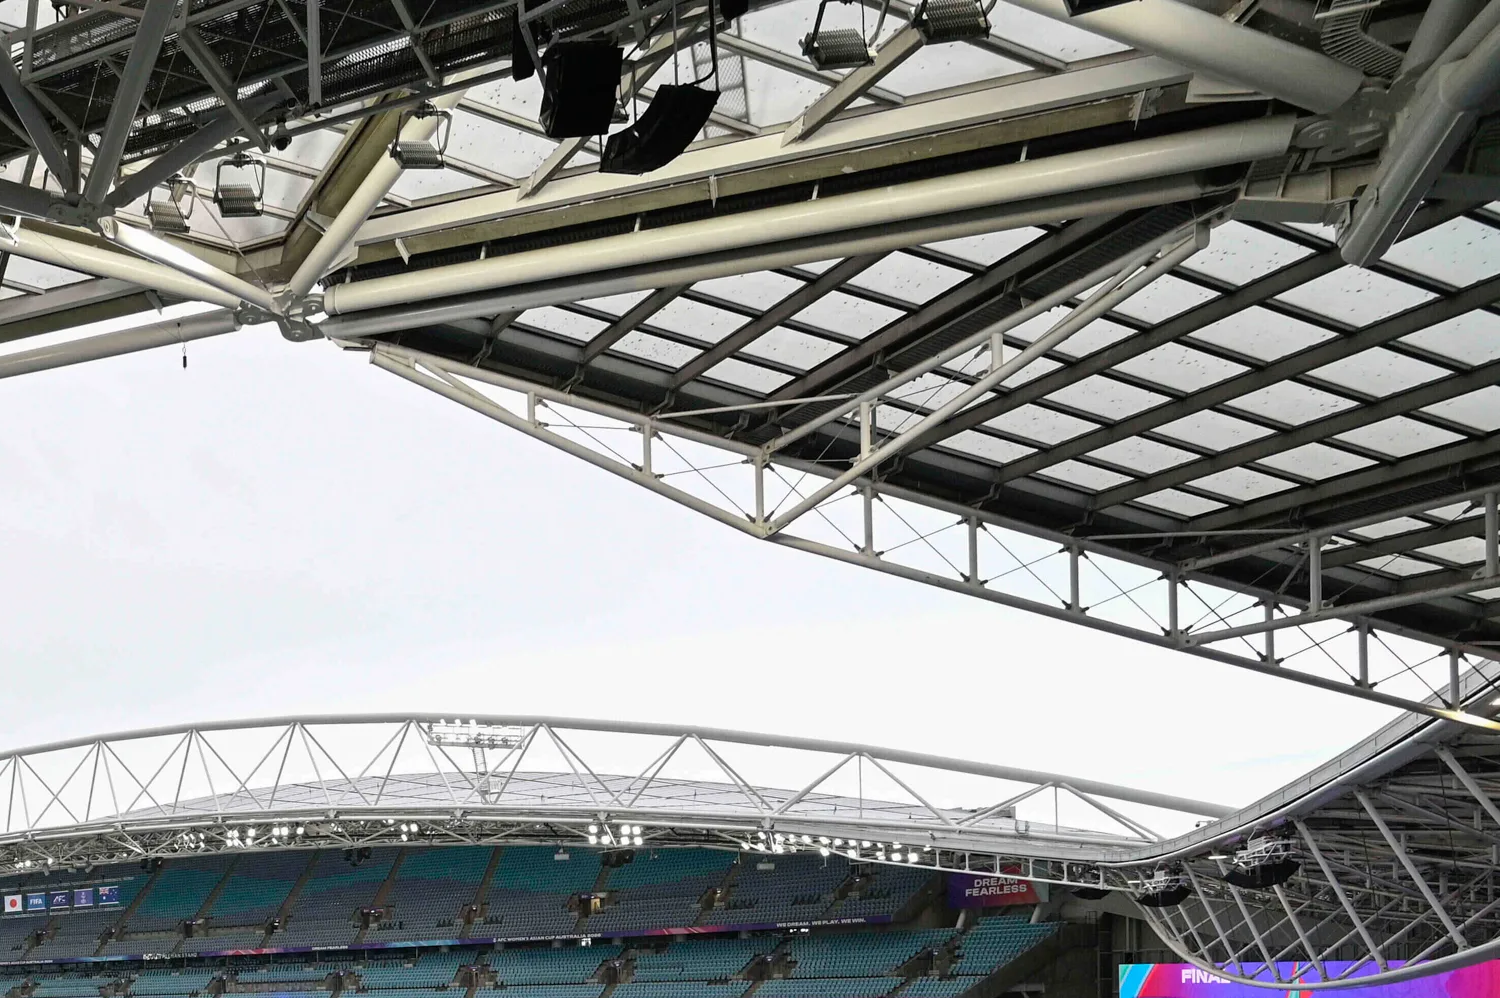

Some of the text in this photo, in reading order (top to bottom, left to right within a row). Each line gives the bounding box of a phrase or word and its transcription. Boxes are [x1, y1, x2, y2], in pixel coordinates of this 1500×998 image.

[974, 877, 1017, 887] DREAM
[966, 884, 1027, 897] FEARLESS
[53, 895, 66, 904] AFC
